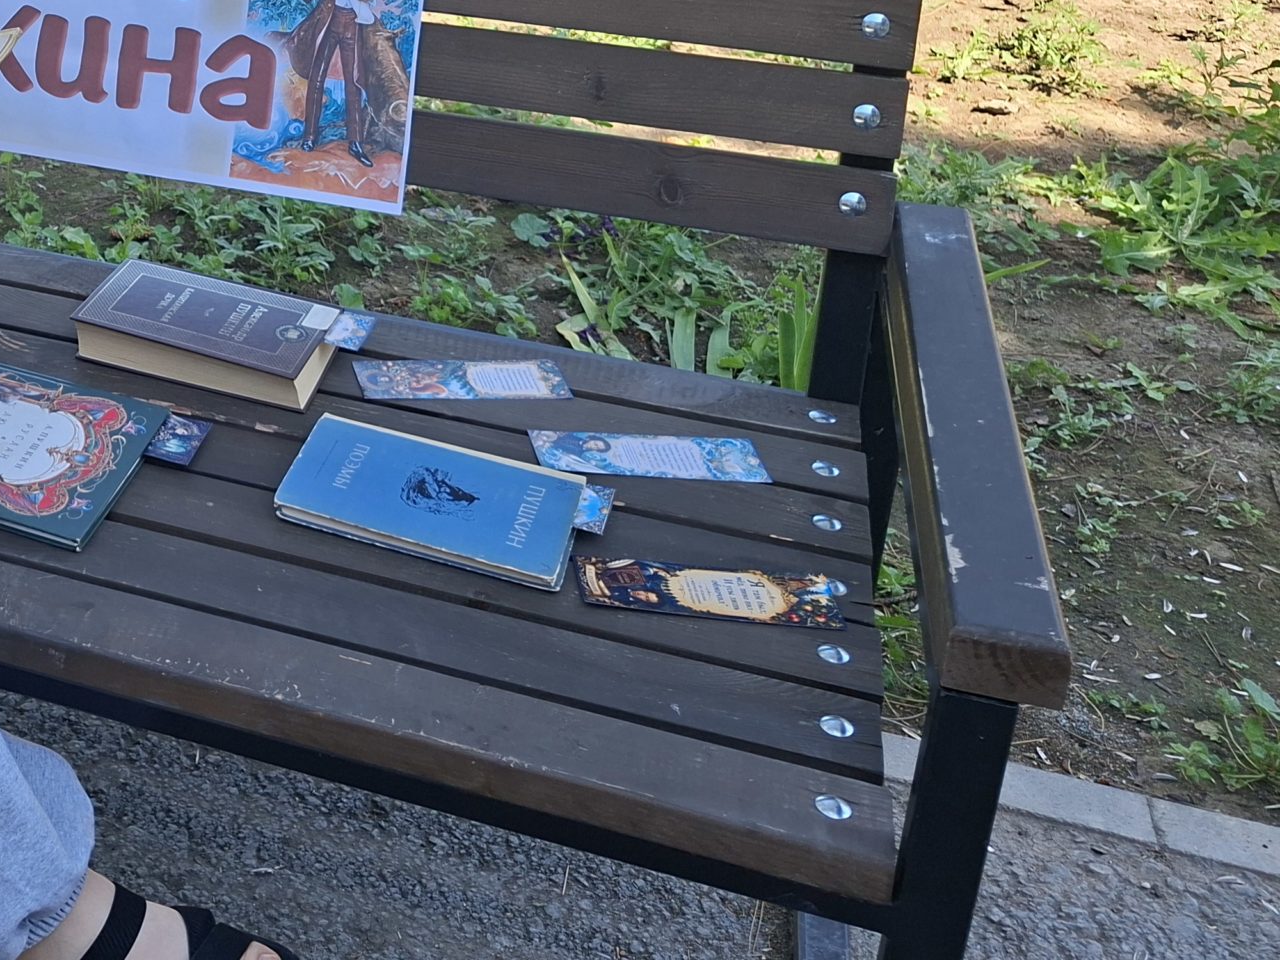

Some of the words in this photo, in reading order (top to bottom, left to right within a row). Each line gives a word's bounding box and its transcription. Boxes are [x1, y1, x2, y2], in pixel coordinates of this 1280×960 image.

[218, 302, 252, 337] ПУШКИН
[332, 442, 370, 490] ПОЭМЫ
[505, 484, 546, 549] ПУШКИН
